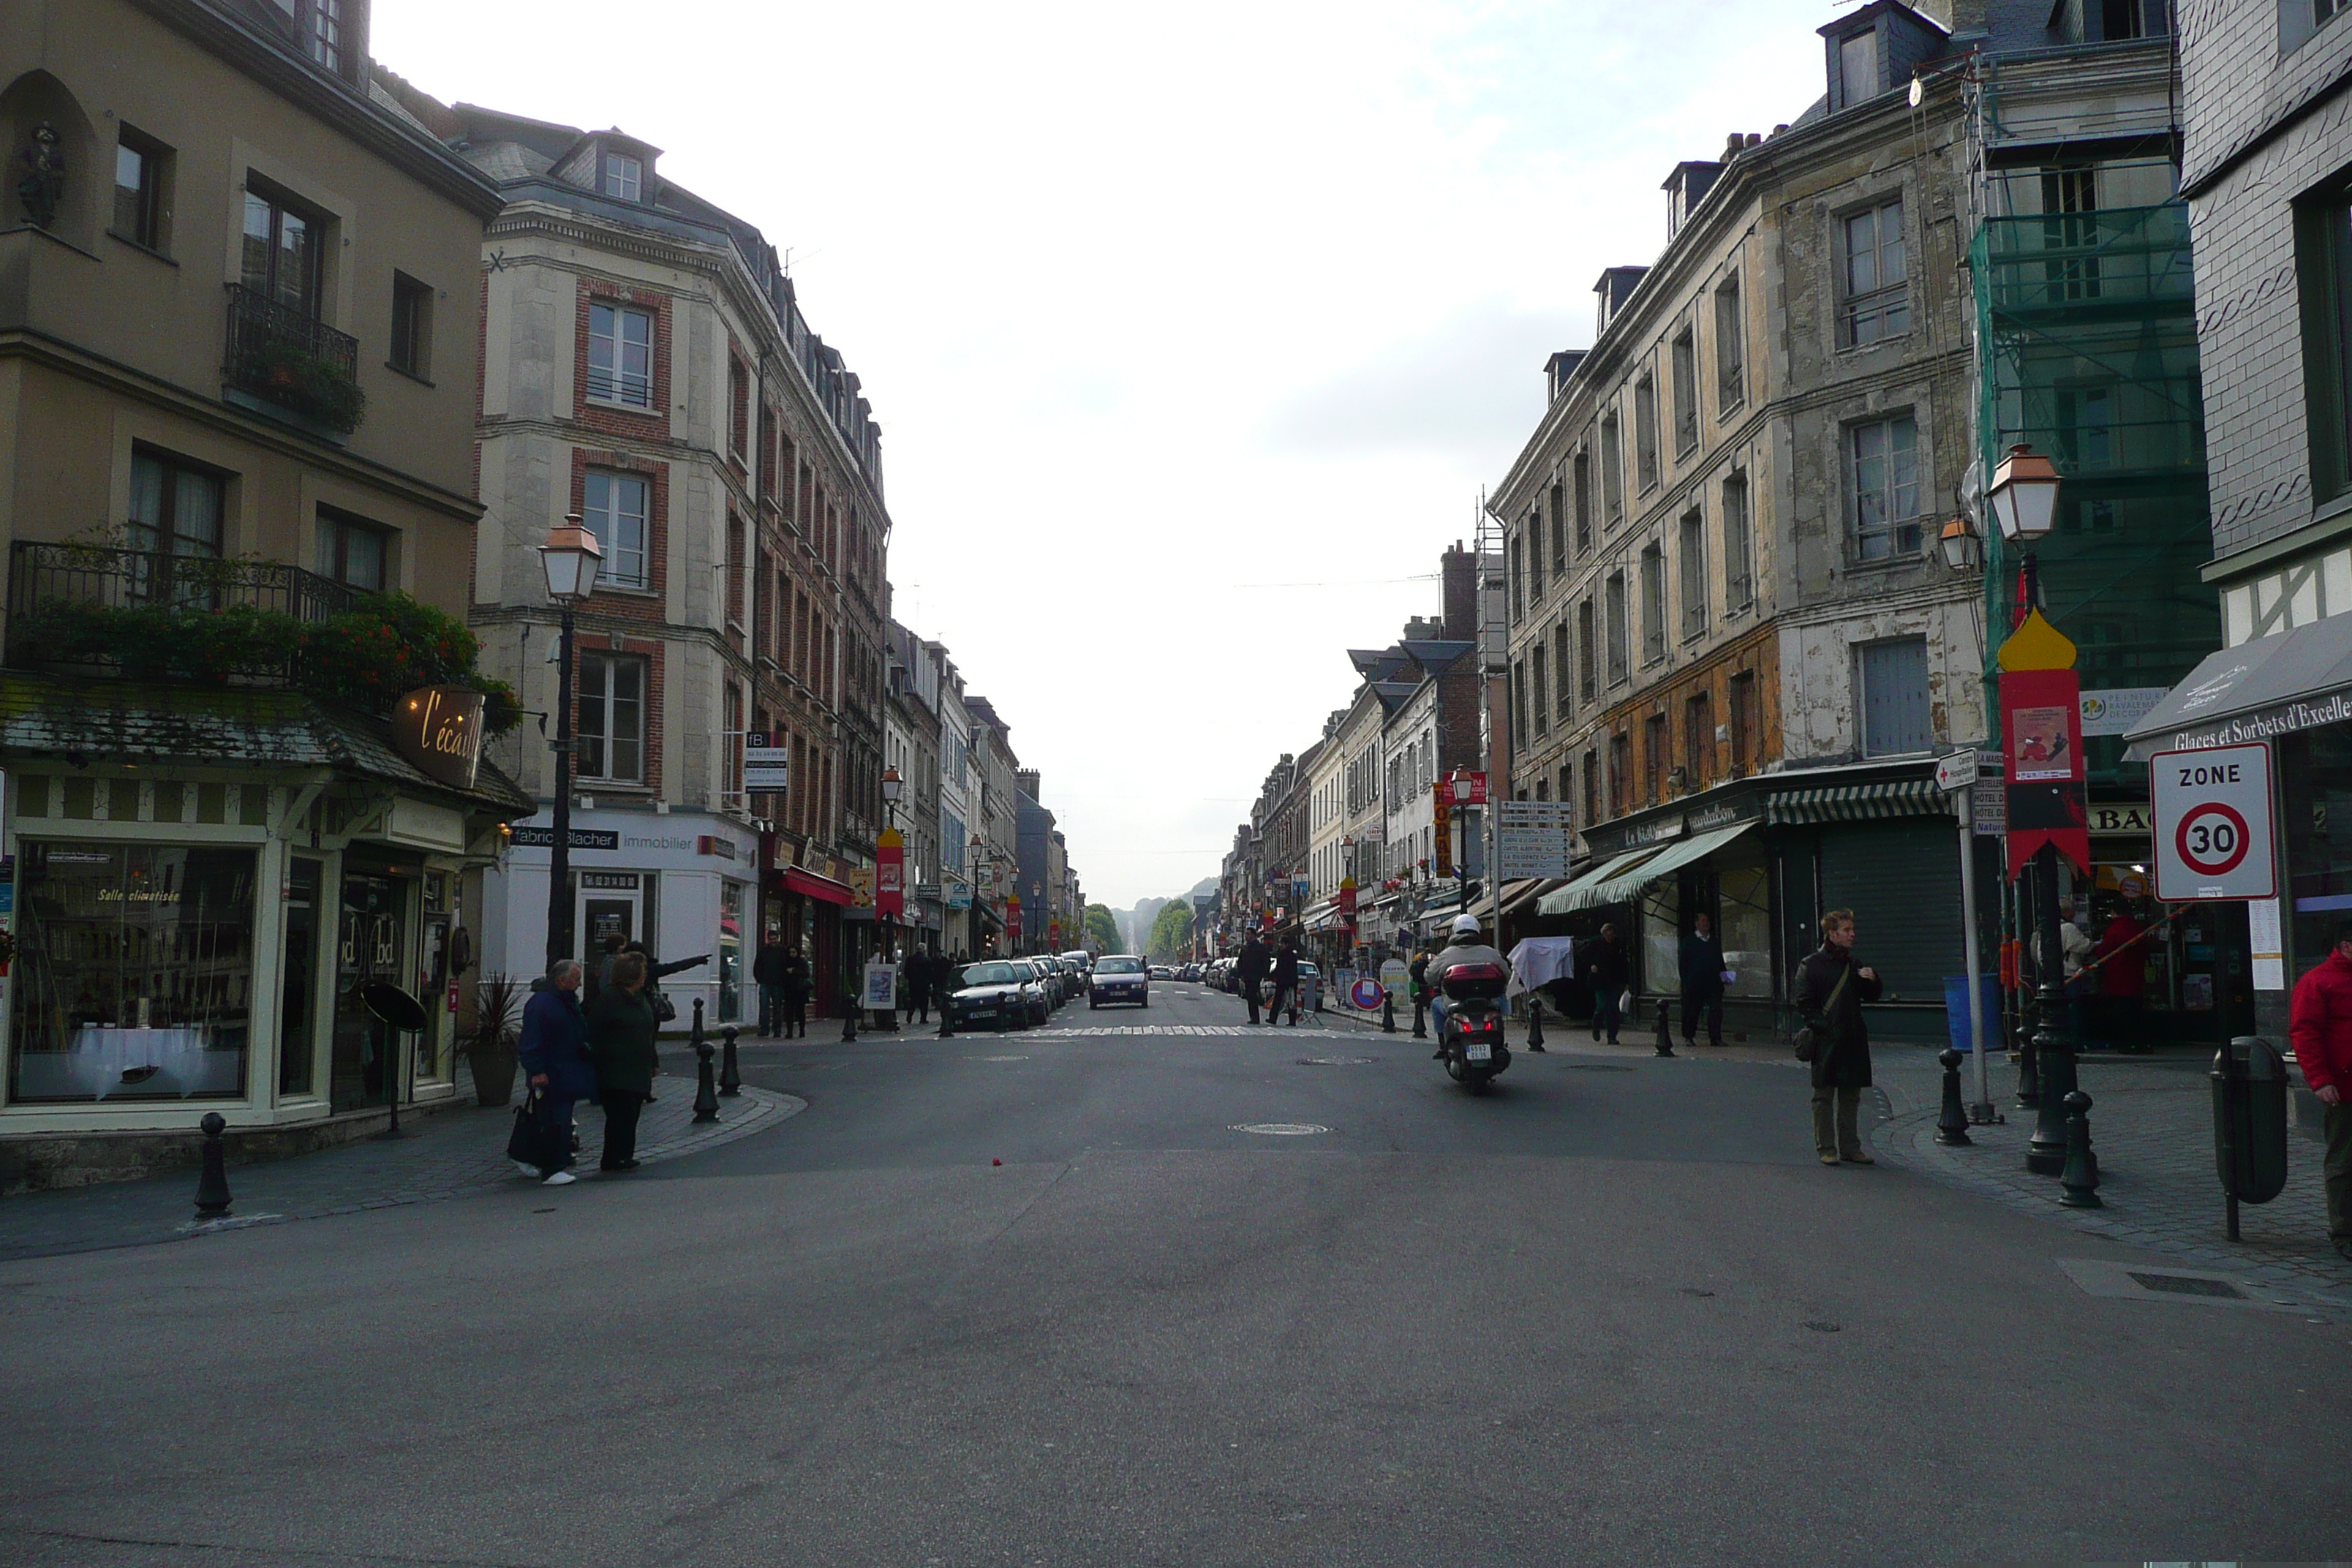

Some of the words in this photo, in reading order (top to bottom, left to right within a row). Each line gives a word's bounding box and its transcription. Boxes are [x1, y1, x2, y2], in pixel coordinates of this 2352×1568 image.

[2176, 733, 2216, 751] Glaces
[2218, 726, 2231, 744] et
[2232, 715, 2285, 742] Sorbets
[2287, 695, 2352, 730] d'Excelle
[748, 734, 764, 747] fB
[1959, 756, 1973, 766] Centre
[1950, 766, 1974, 778] Hospitalier
[2179, 764, 2241, 787] ZONE
[1975, 807, 1994, 817] HÔTEL
[1434, 790, 1451, 869] KODAK
[515, 829, 554, 843] fabric
[624, 834, 693, 850] immobilier
[2191, 823, 2234, 854] 30
[97, 889, 124, 901] Salle
[128, 889, 181, 902] climatisée
